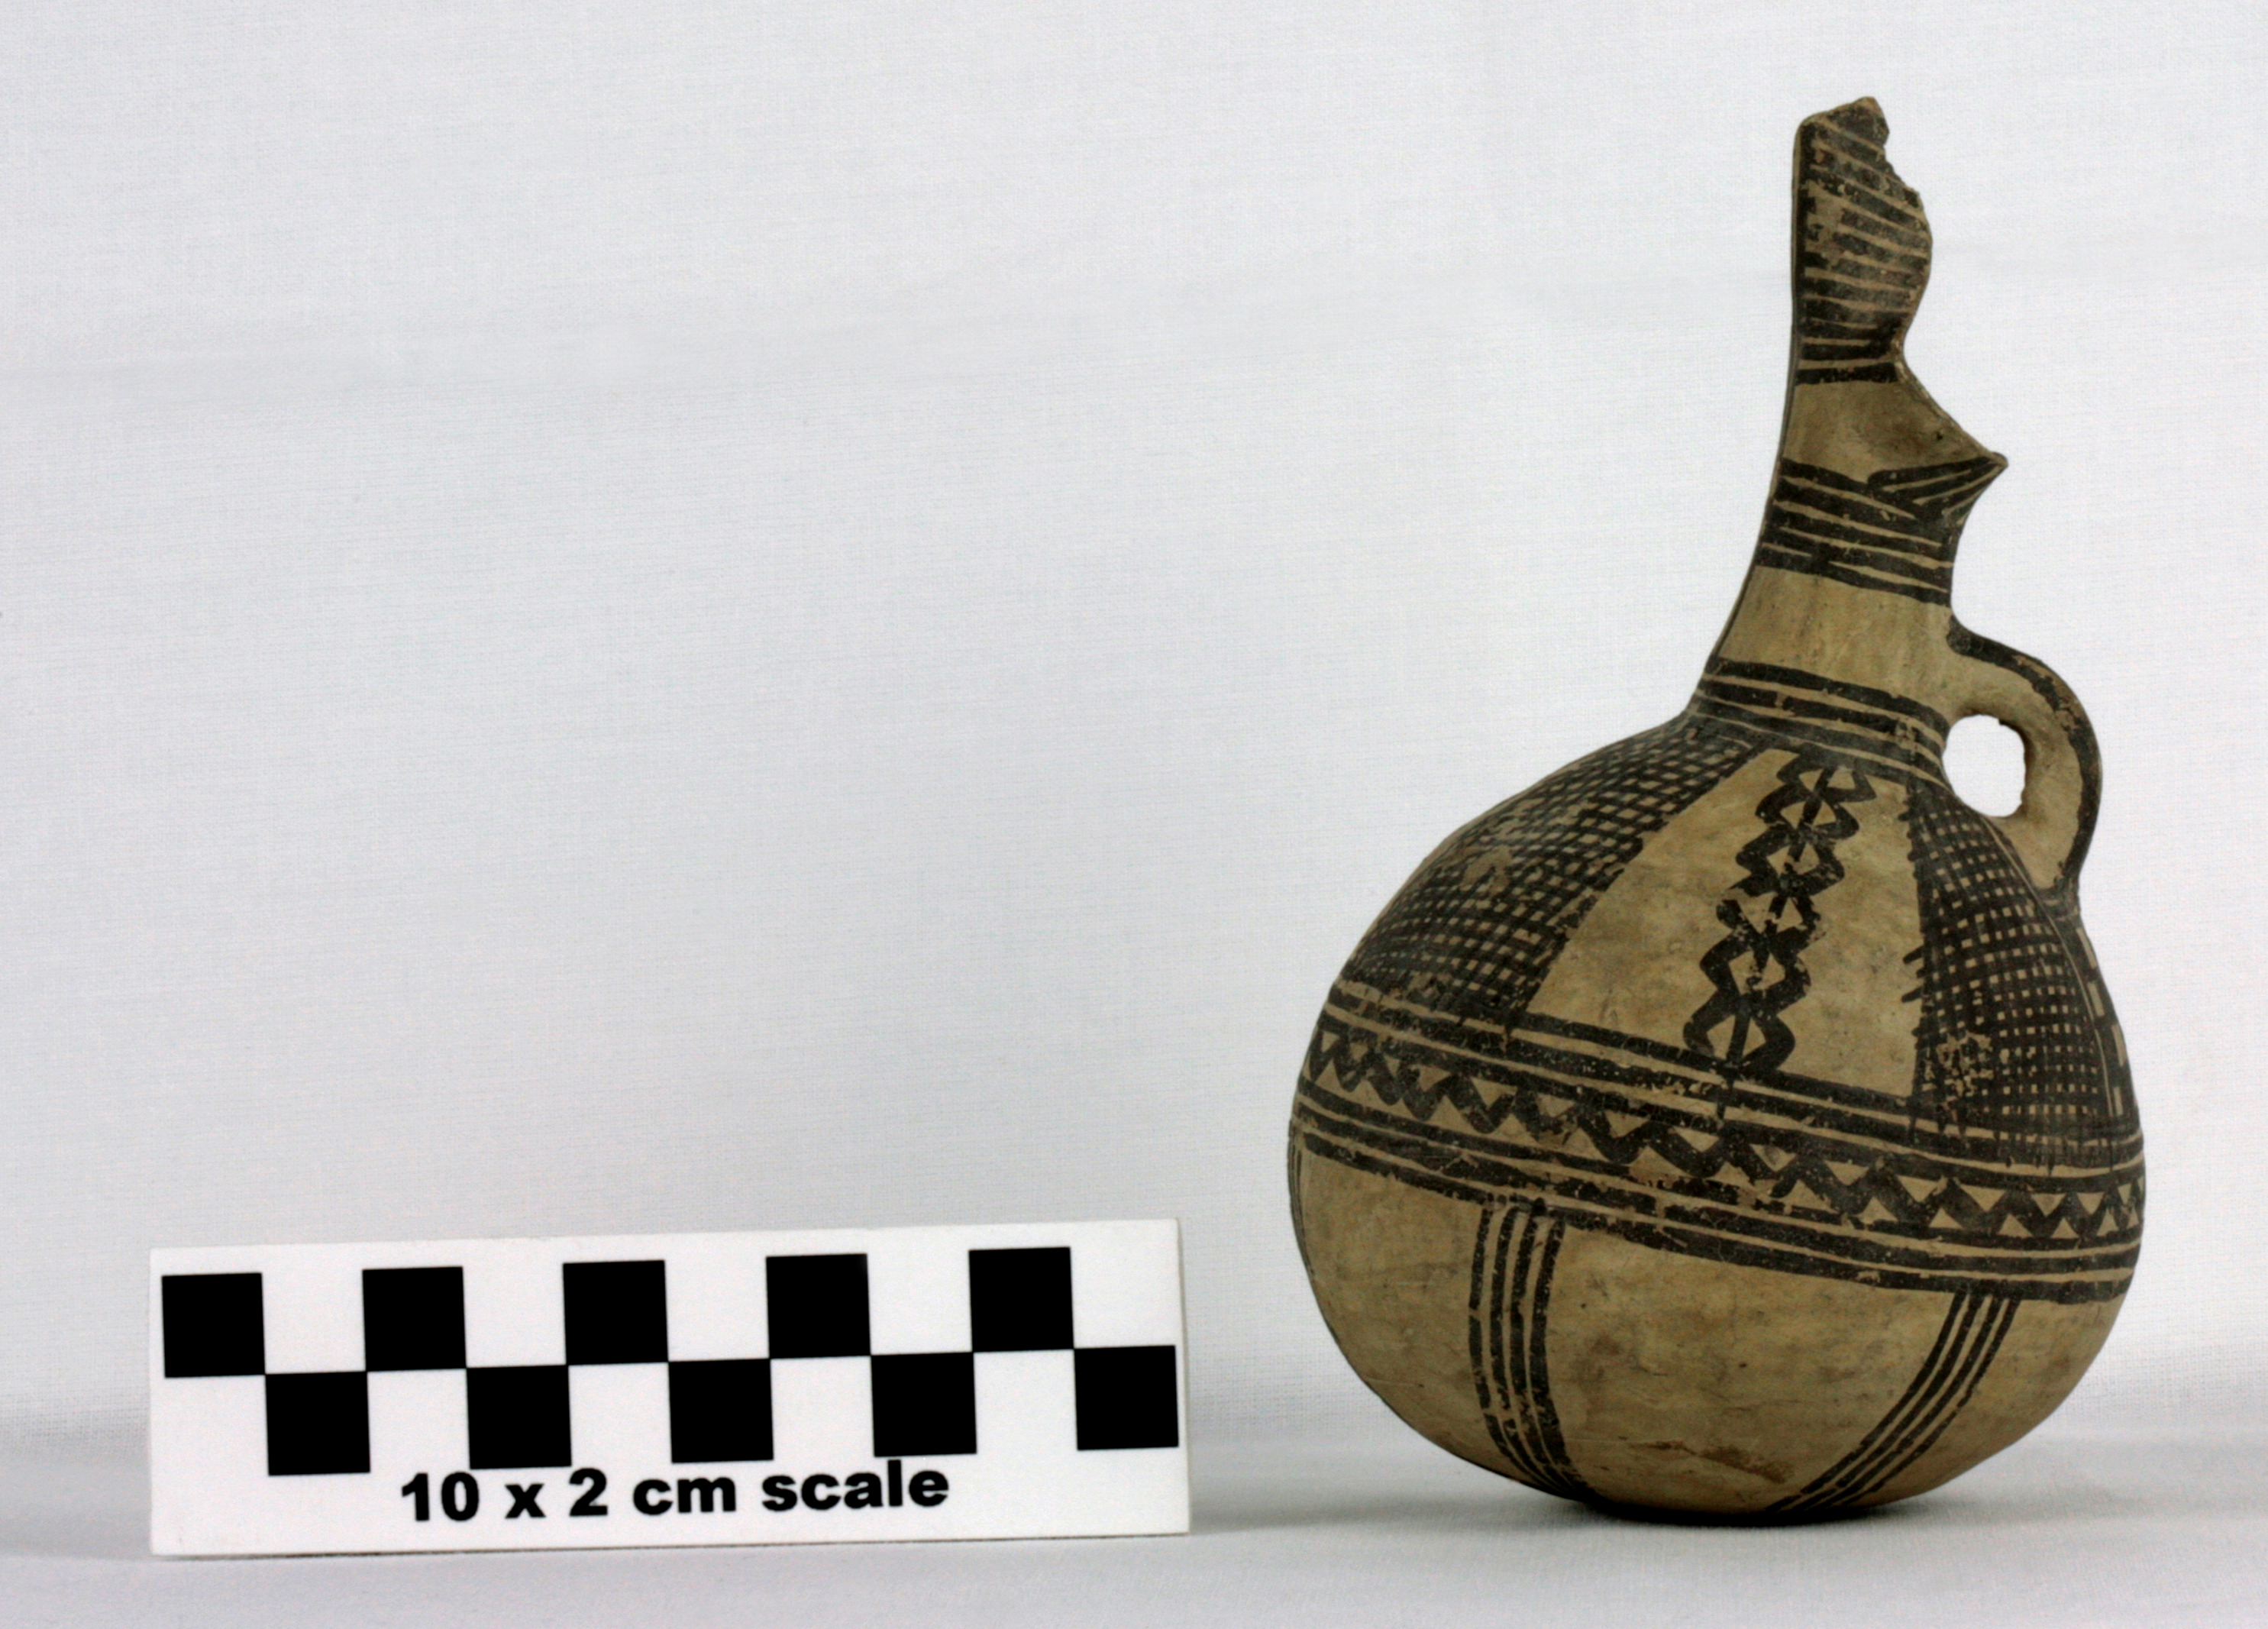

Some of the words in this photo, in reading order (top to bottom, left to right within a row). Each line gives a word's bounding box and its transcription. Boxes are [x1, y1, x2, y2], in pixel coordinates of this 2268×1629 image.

[401, 1471, 480, 1522] 10
[505, 1483, 546, 1519] x
[569, 1467, 608, 1517] 2
[632, 1476, 737, 1516] cm
[761, 1459, 949, 1512] scale
